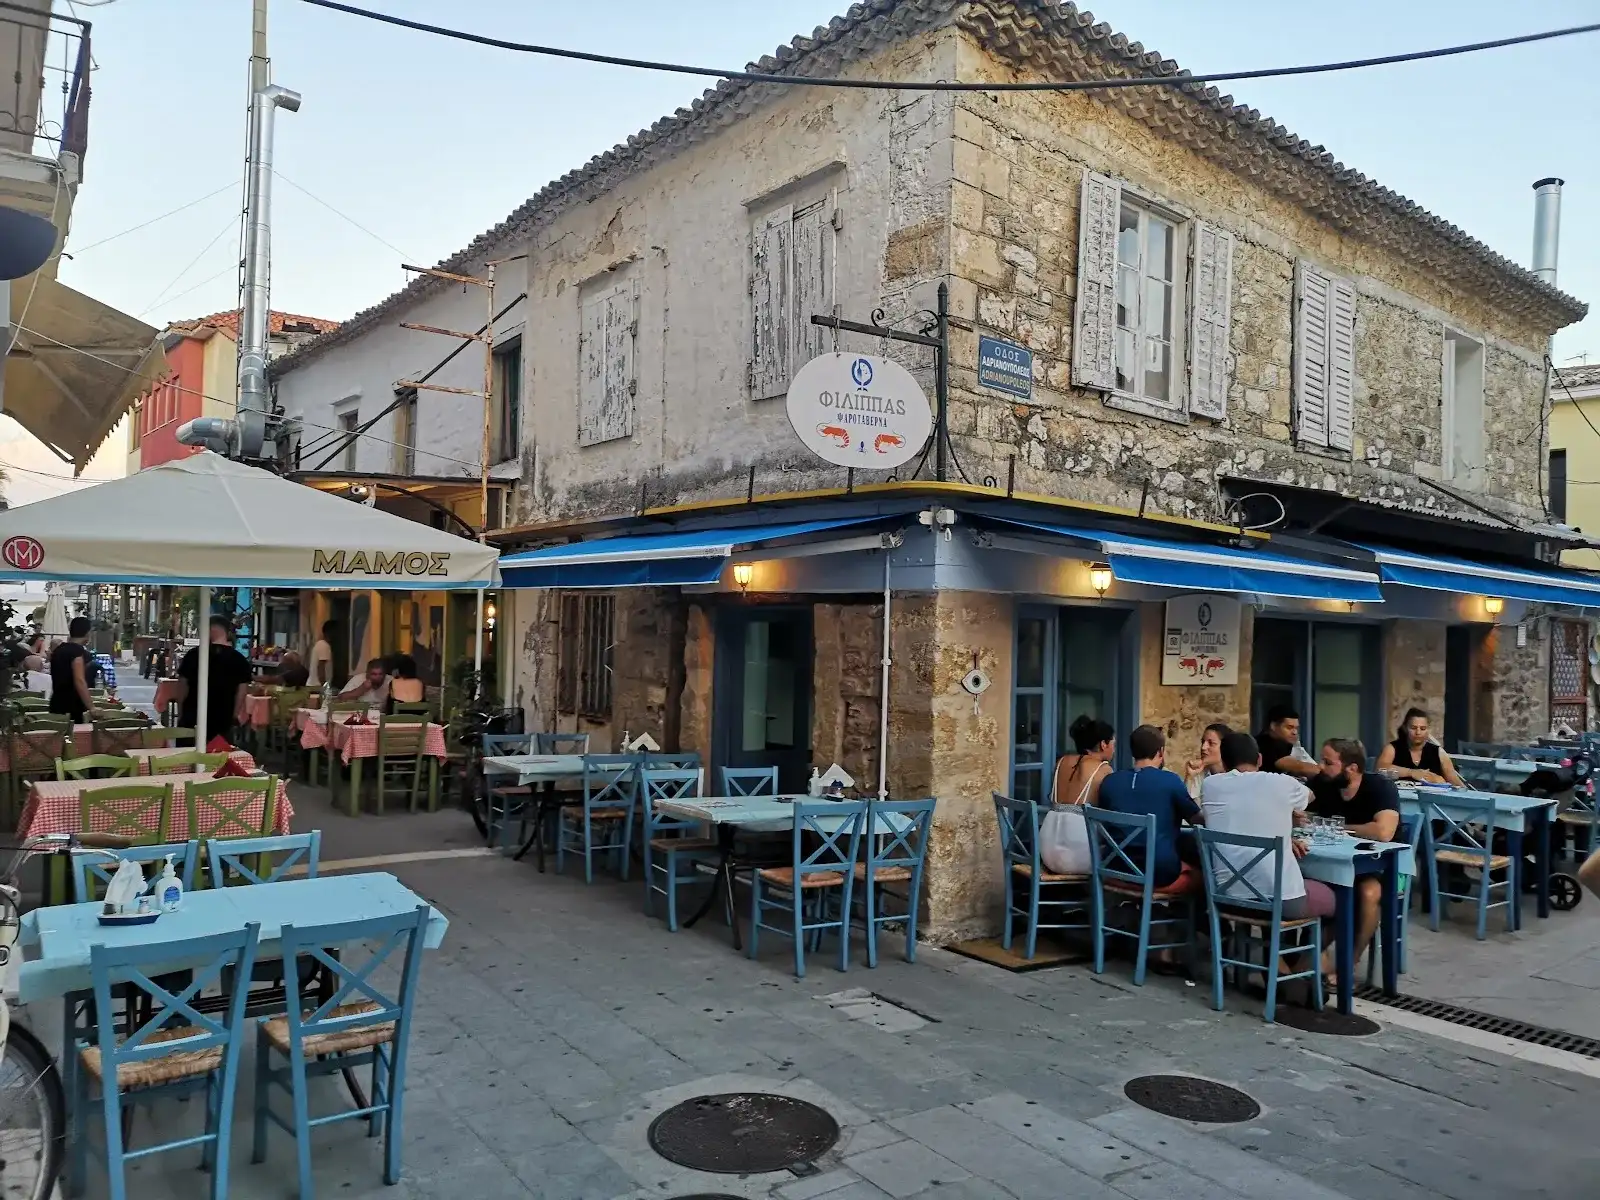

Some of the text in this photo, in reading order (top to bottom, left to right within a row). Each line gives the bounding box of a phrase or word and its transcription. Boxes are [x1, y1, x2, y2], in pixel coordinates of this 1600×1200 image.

[995, 346, 1020, 362] ΟΔΟΣ
[982, 356, 1030, 377] ΑΔΡΙΑΝΟΥΠΟΛΕΩΣ
[981, 369, 1030, 390] ADRIANOUPOLEOS
[837, 412, 887, 427] ΨΑΡΟΤΑΒΕΡΝΑ
[313, 549, 451, 576] ΜΑΜΟΣ
